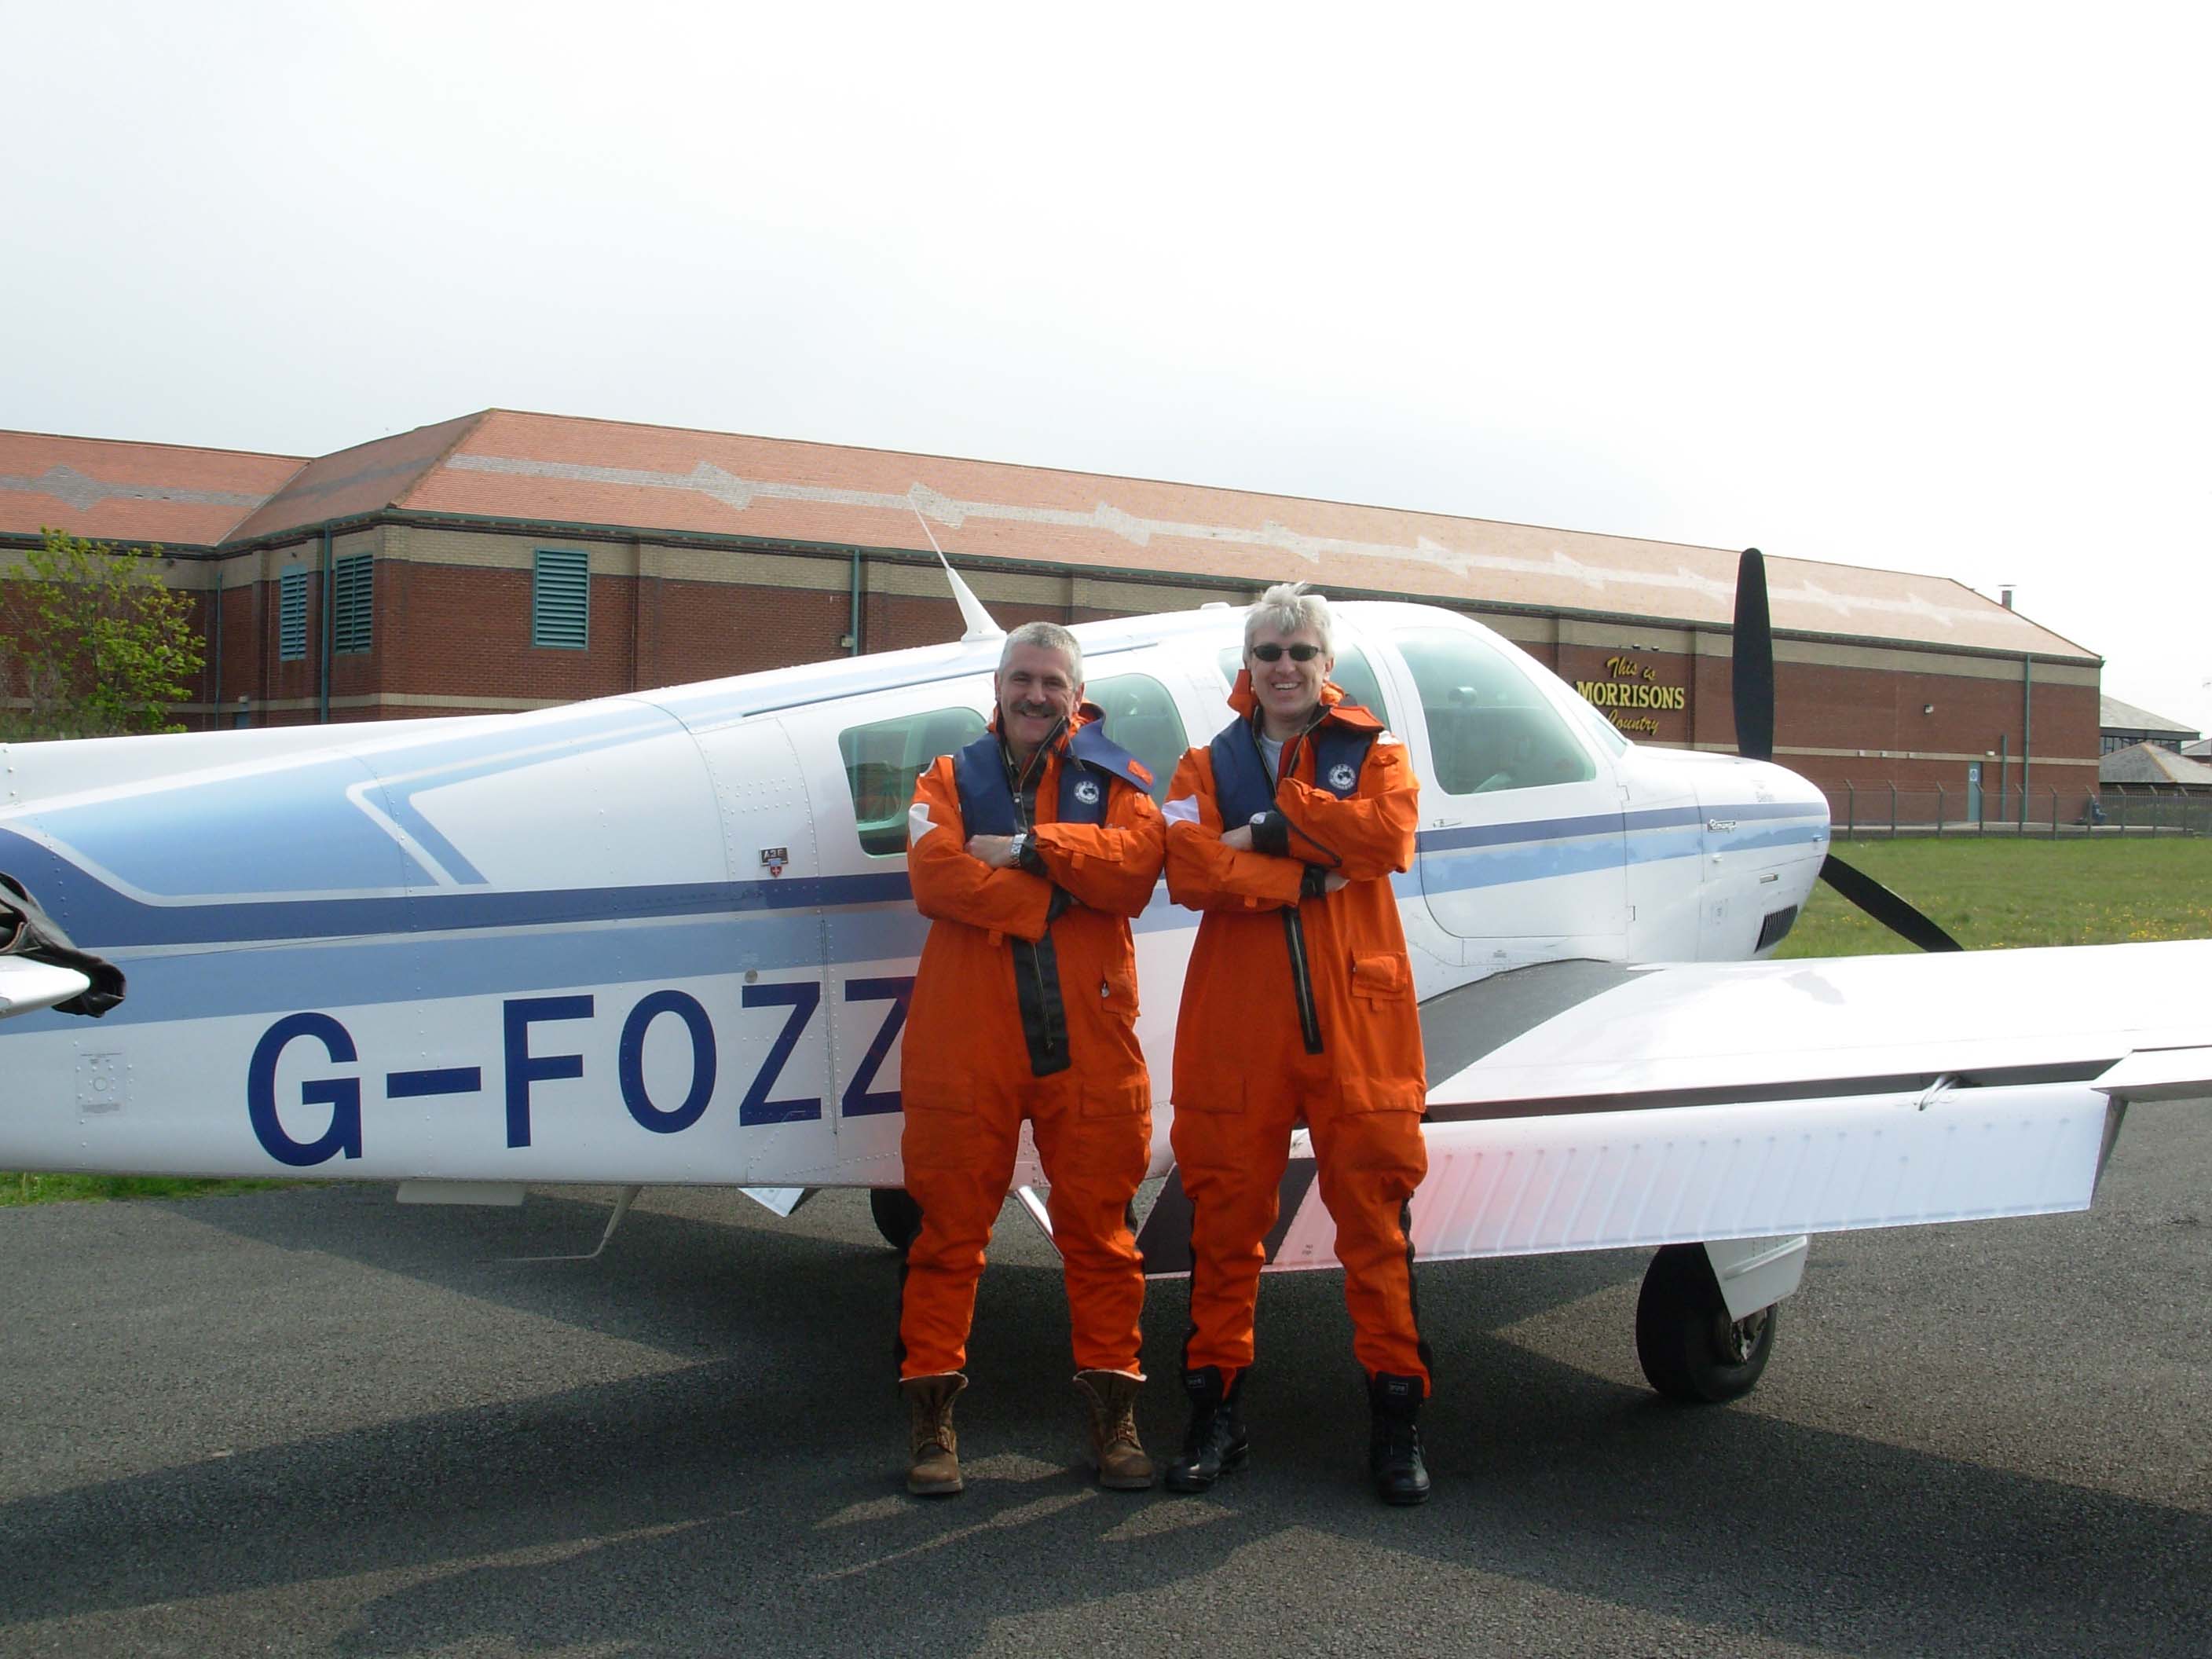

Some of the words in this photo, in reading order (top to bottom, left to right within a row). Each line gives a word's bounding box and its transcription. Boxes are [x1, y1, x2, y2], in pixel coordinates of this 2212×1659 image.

[1607, 656, 1638, 678] This
[1643, 665, 1657, 681] is
[1576, 681, 1685, 709] MORRISONS
[247, 976, 916, 1166] G-FOZZ
